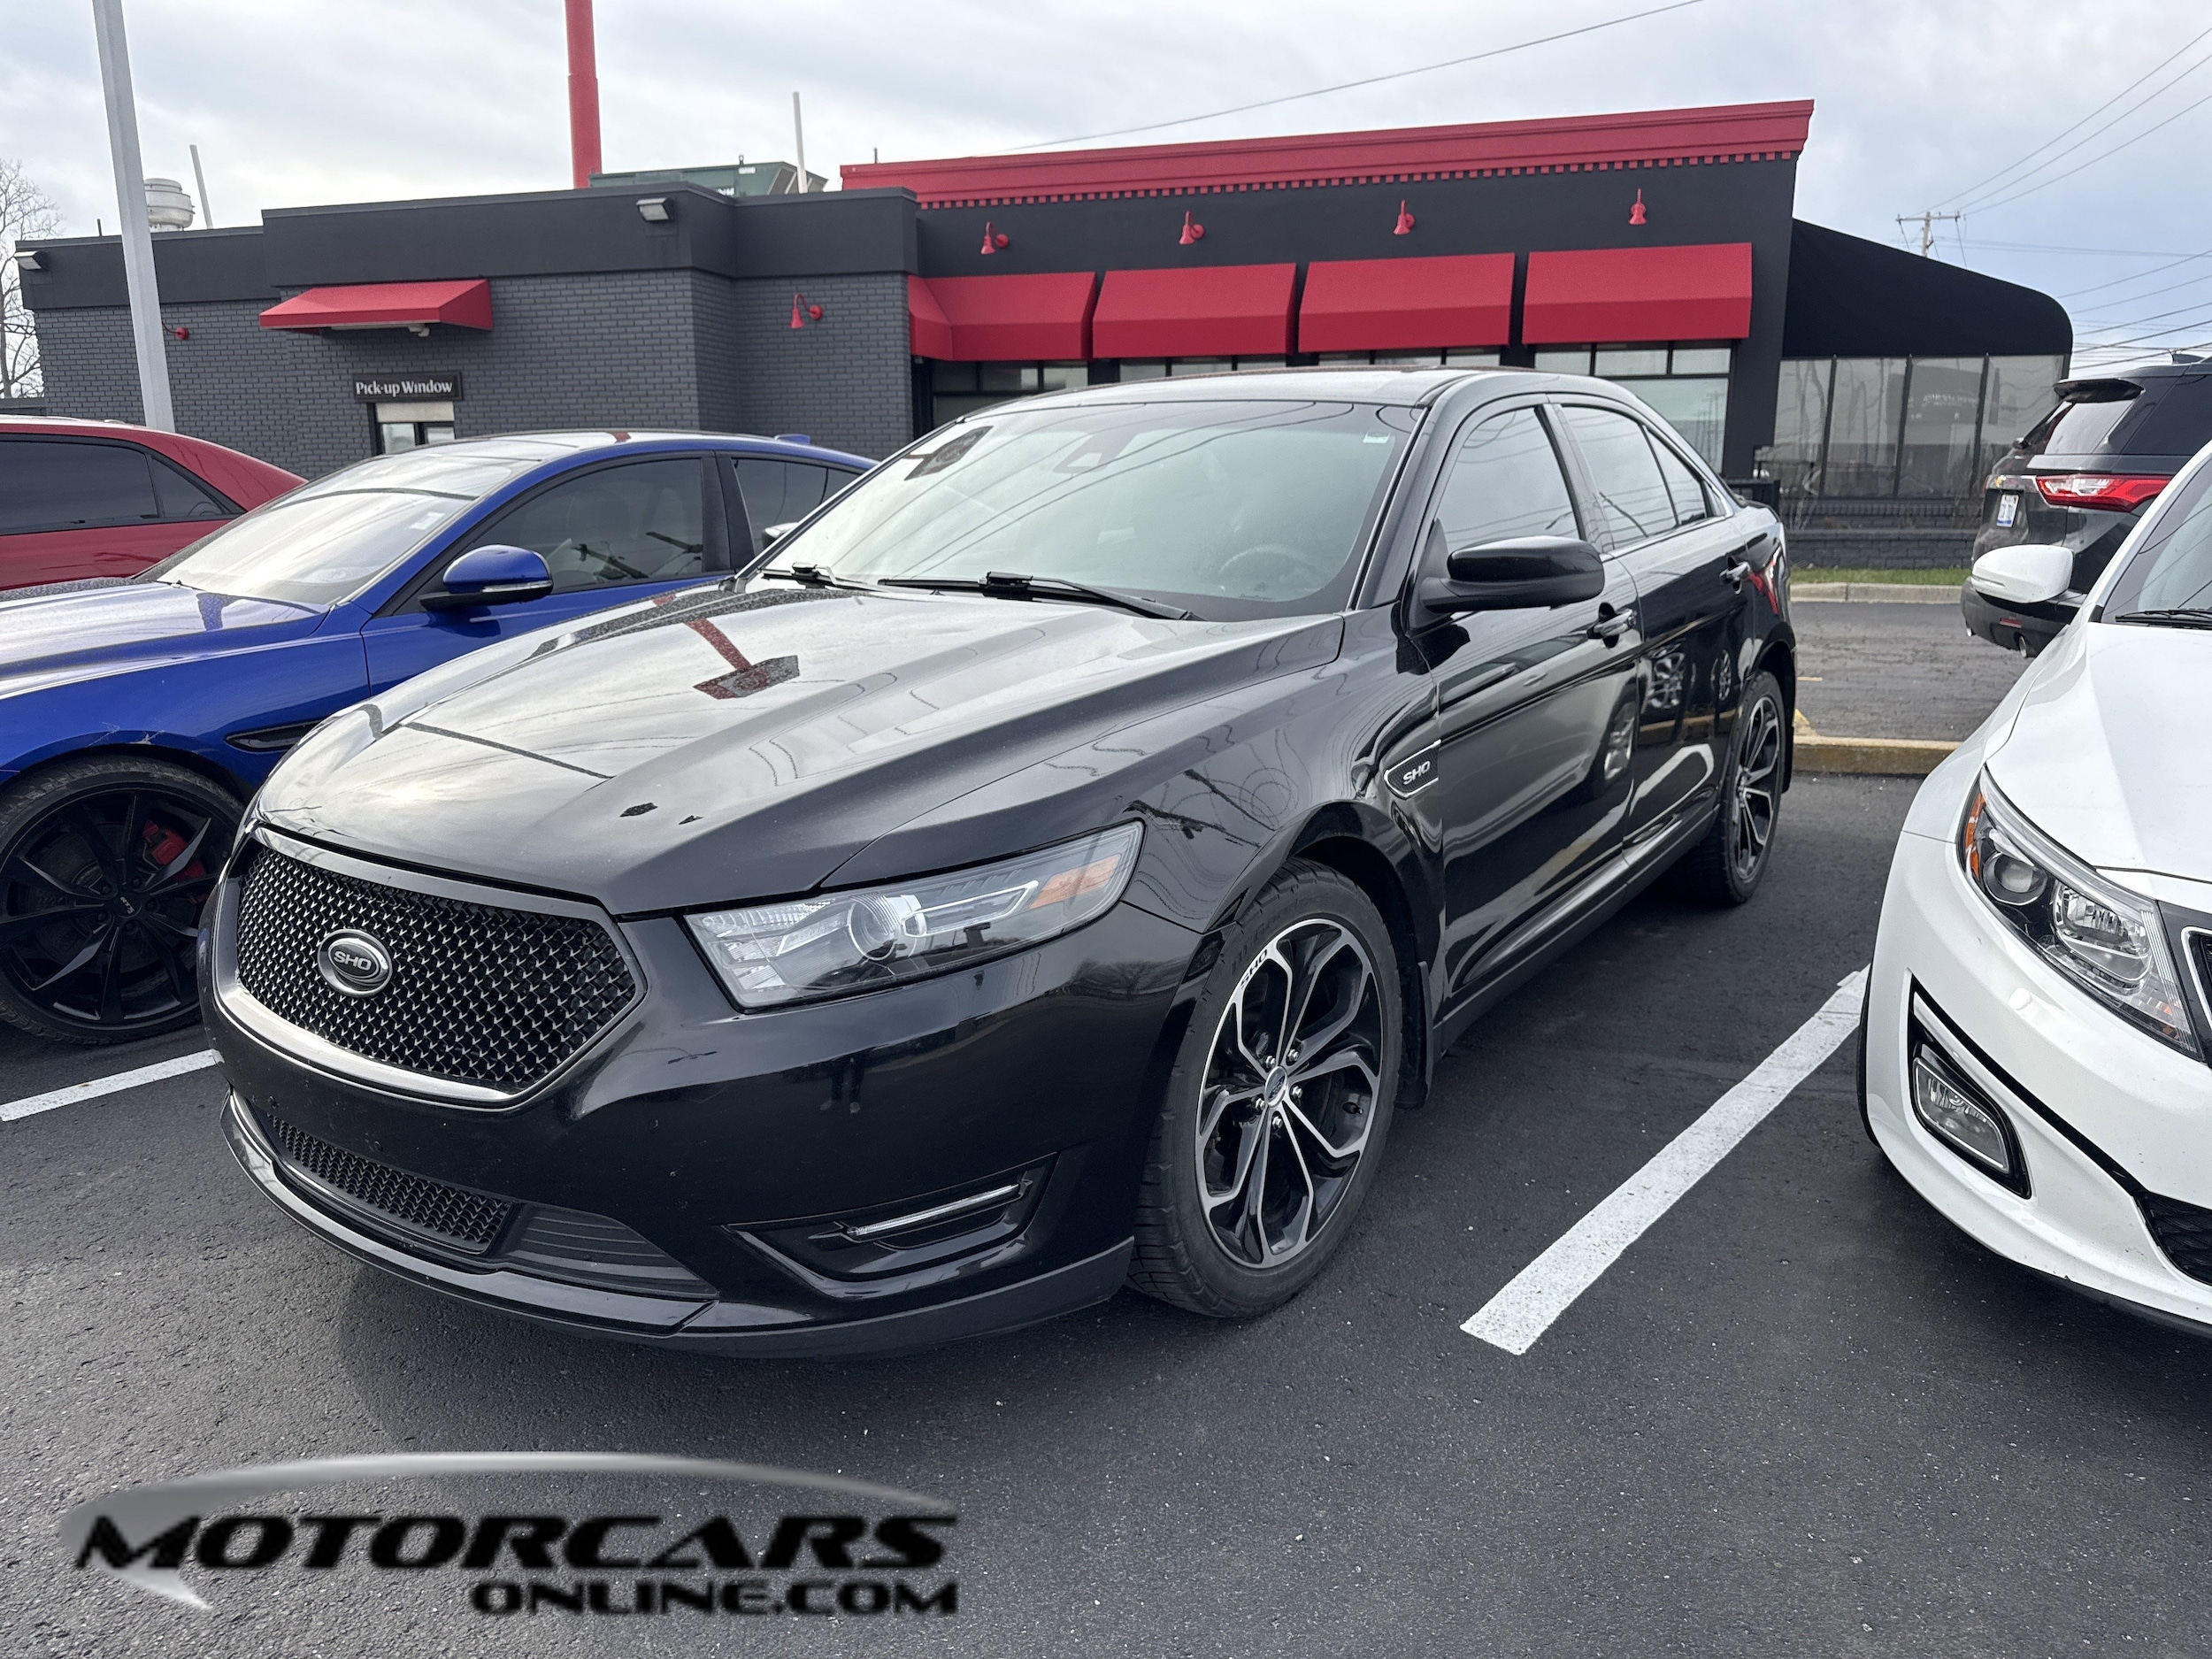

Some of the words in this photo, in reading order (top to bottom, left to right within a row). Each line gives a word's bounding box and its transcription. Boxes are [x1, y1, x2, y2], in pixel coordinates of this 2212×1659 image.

[356, 380, 400, 397] Pick-up
[401, 380, 452, 394] Window
[1403, 761, 1431, 785] SHO
[334, 950, 372, 971] SHO
[1240, 949, 1267, 989] SHO
